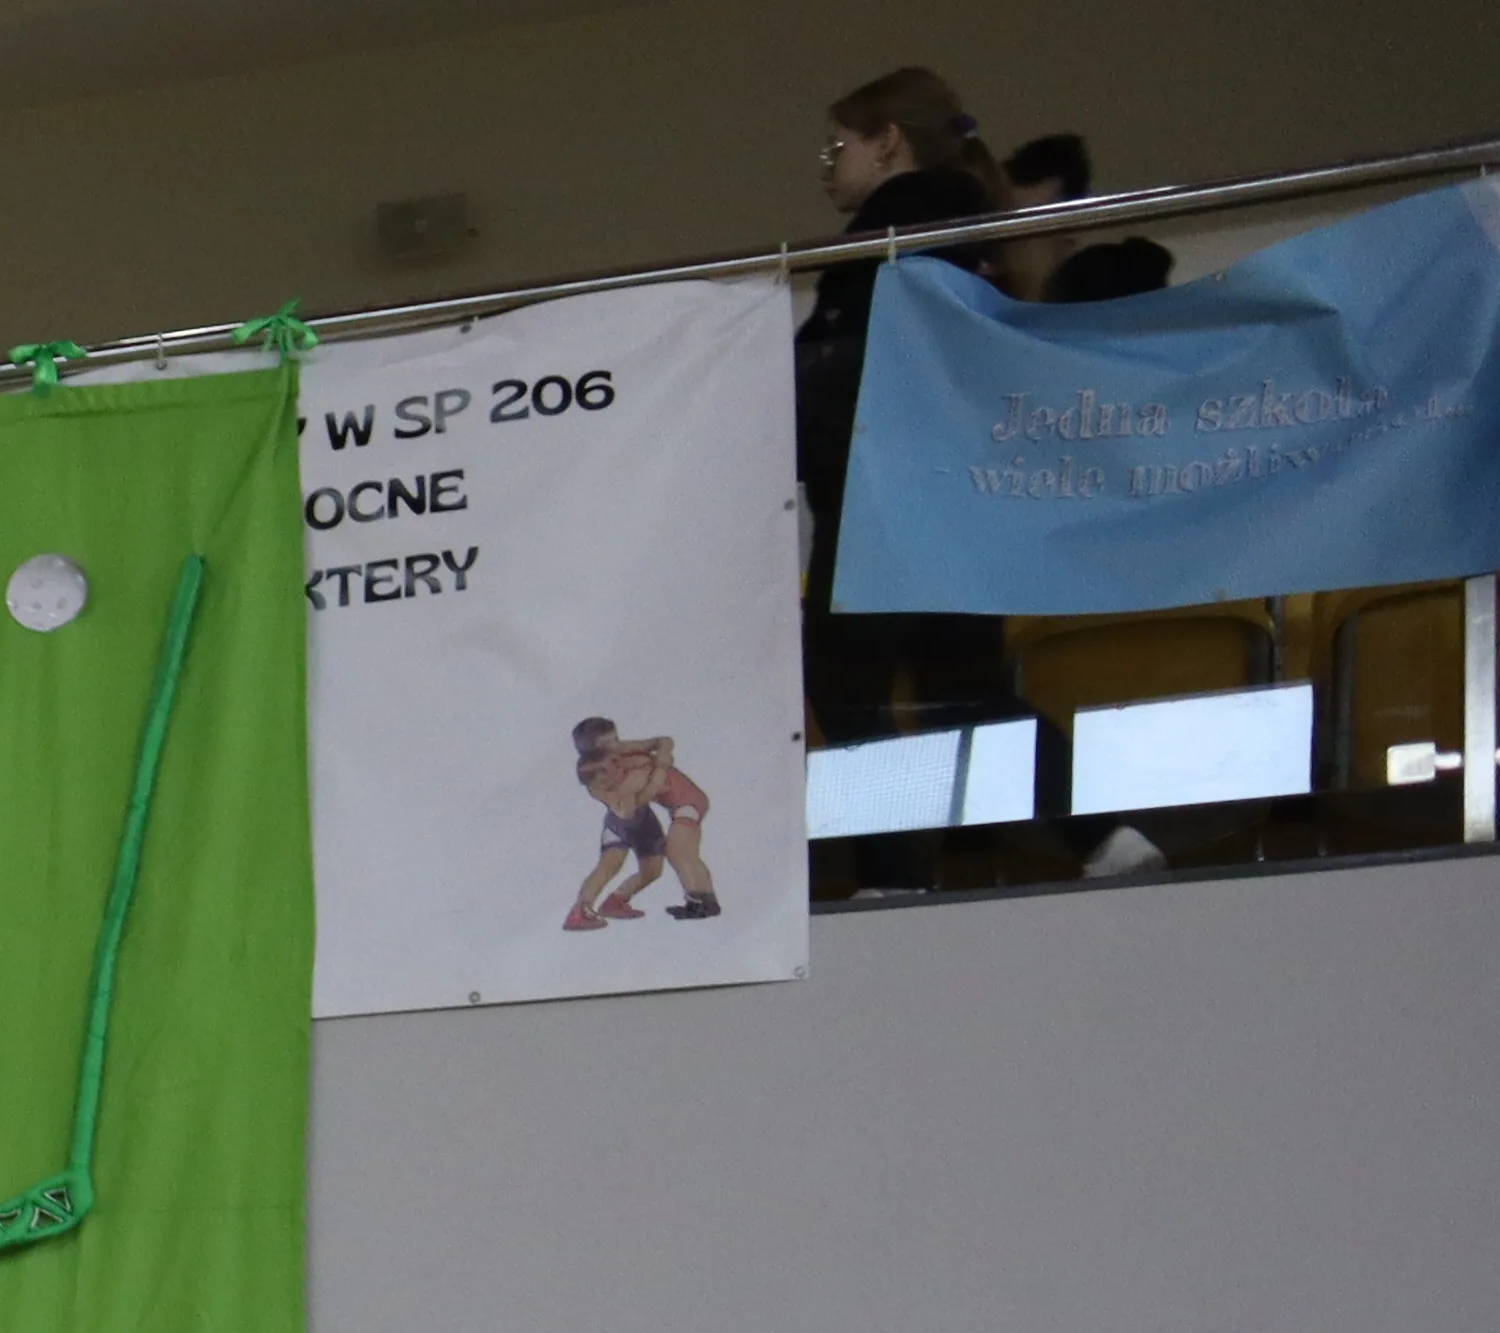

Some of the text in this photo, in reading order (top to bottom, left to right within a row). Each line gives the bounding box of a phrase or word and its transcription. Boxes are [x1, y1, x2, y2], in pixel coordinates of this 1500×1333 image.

[325, 370, 616, 451] W SP 206
